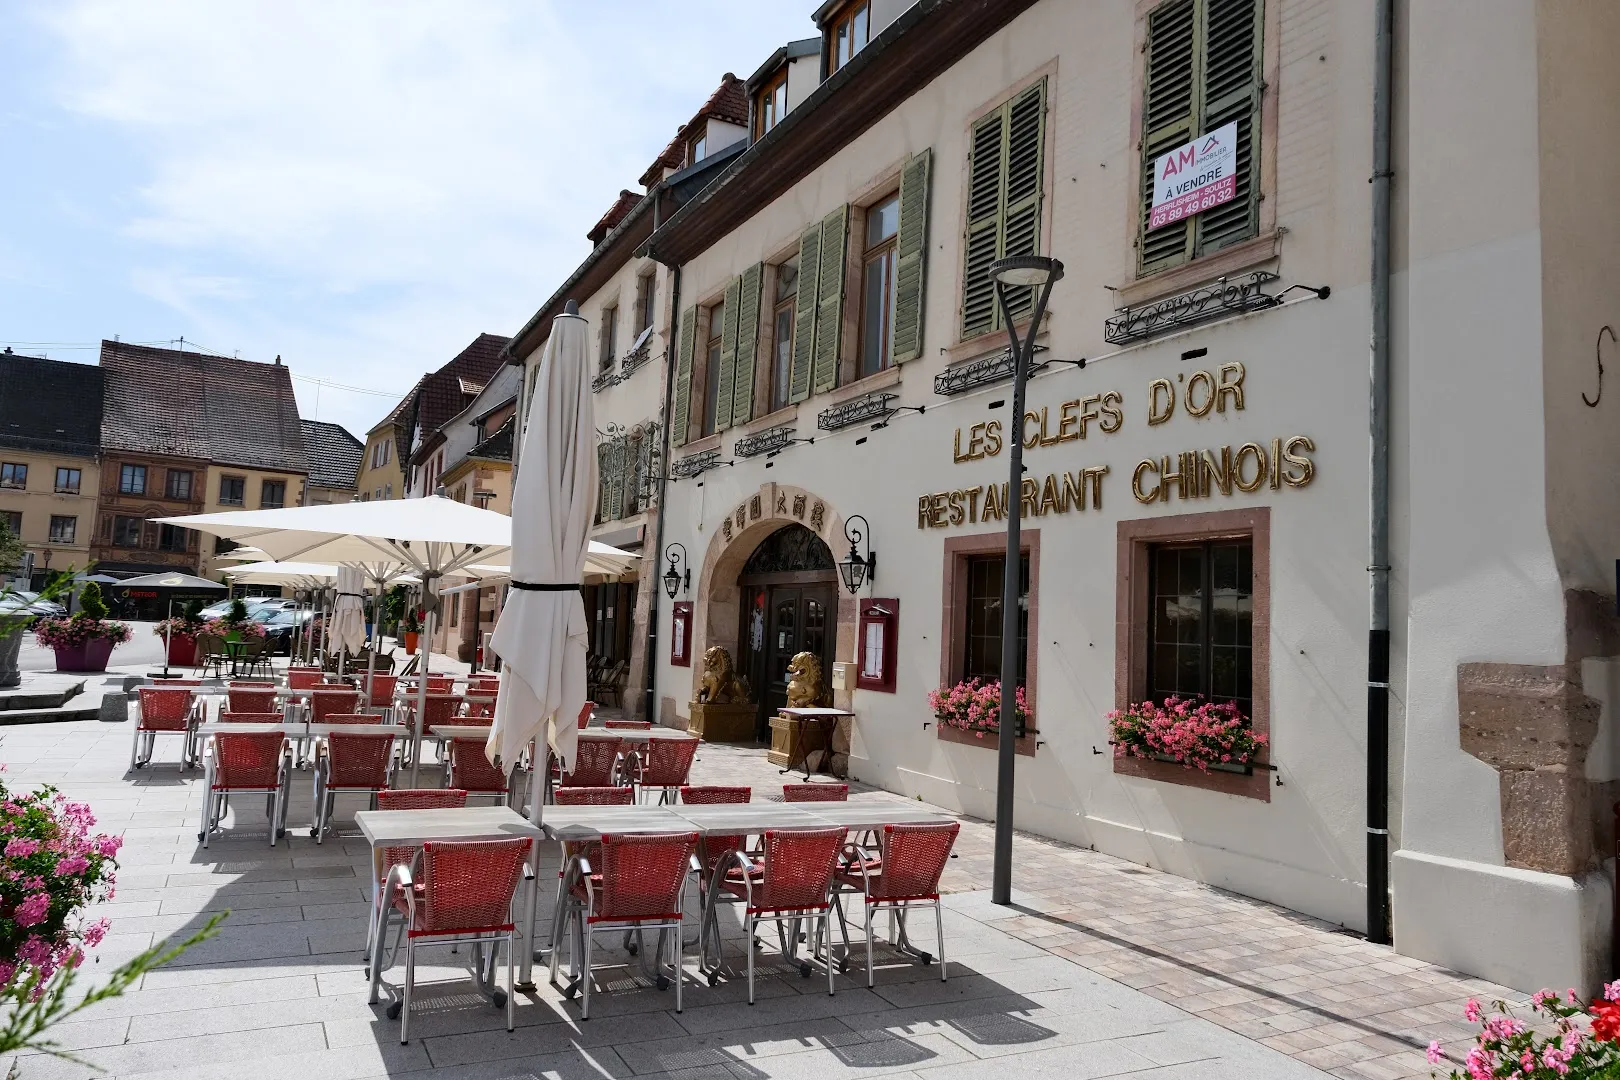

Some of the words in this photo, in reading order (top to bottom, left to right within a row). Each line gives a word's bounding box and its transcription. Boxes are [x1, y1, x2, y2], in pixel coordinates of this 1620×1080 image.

[1162, 145, 1194, 180] AM
[1165, 187, 1173, 200] À
[1176, 166, 1222, 194] VENDRE
[1204, 178, 1231, 195] SOULTZ
[1152, 212, 1167, 227] 03
[1168, 207, 1183, 221] 89
[1184, 200, 1200, 214] 49
[1201, 194, 1216, 209] 60
[1216, 187, 1233, 202] 32
[953, 419, 1003, 464] LES
[1022, 390, 1124, 450] CLEFS
[1147, 361, 1246, 427] D'OR
[1131, 435, 1317, 505] CHINOIS
